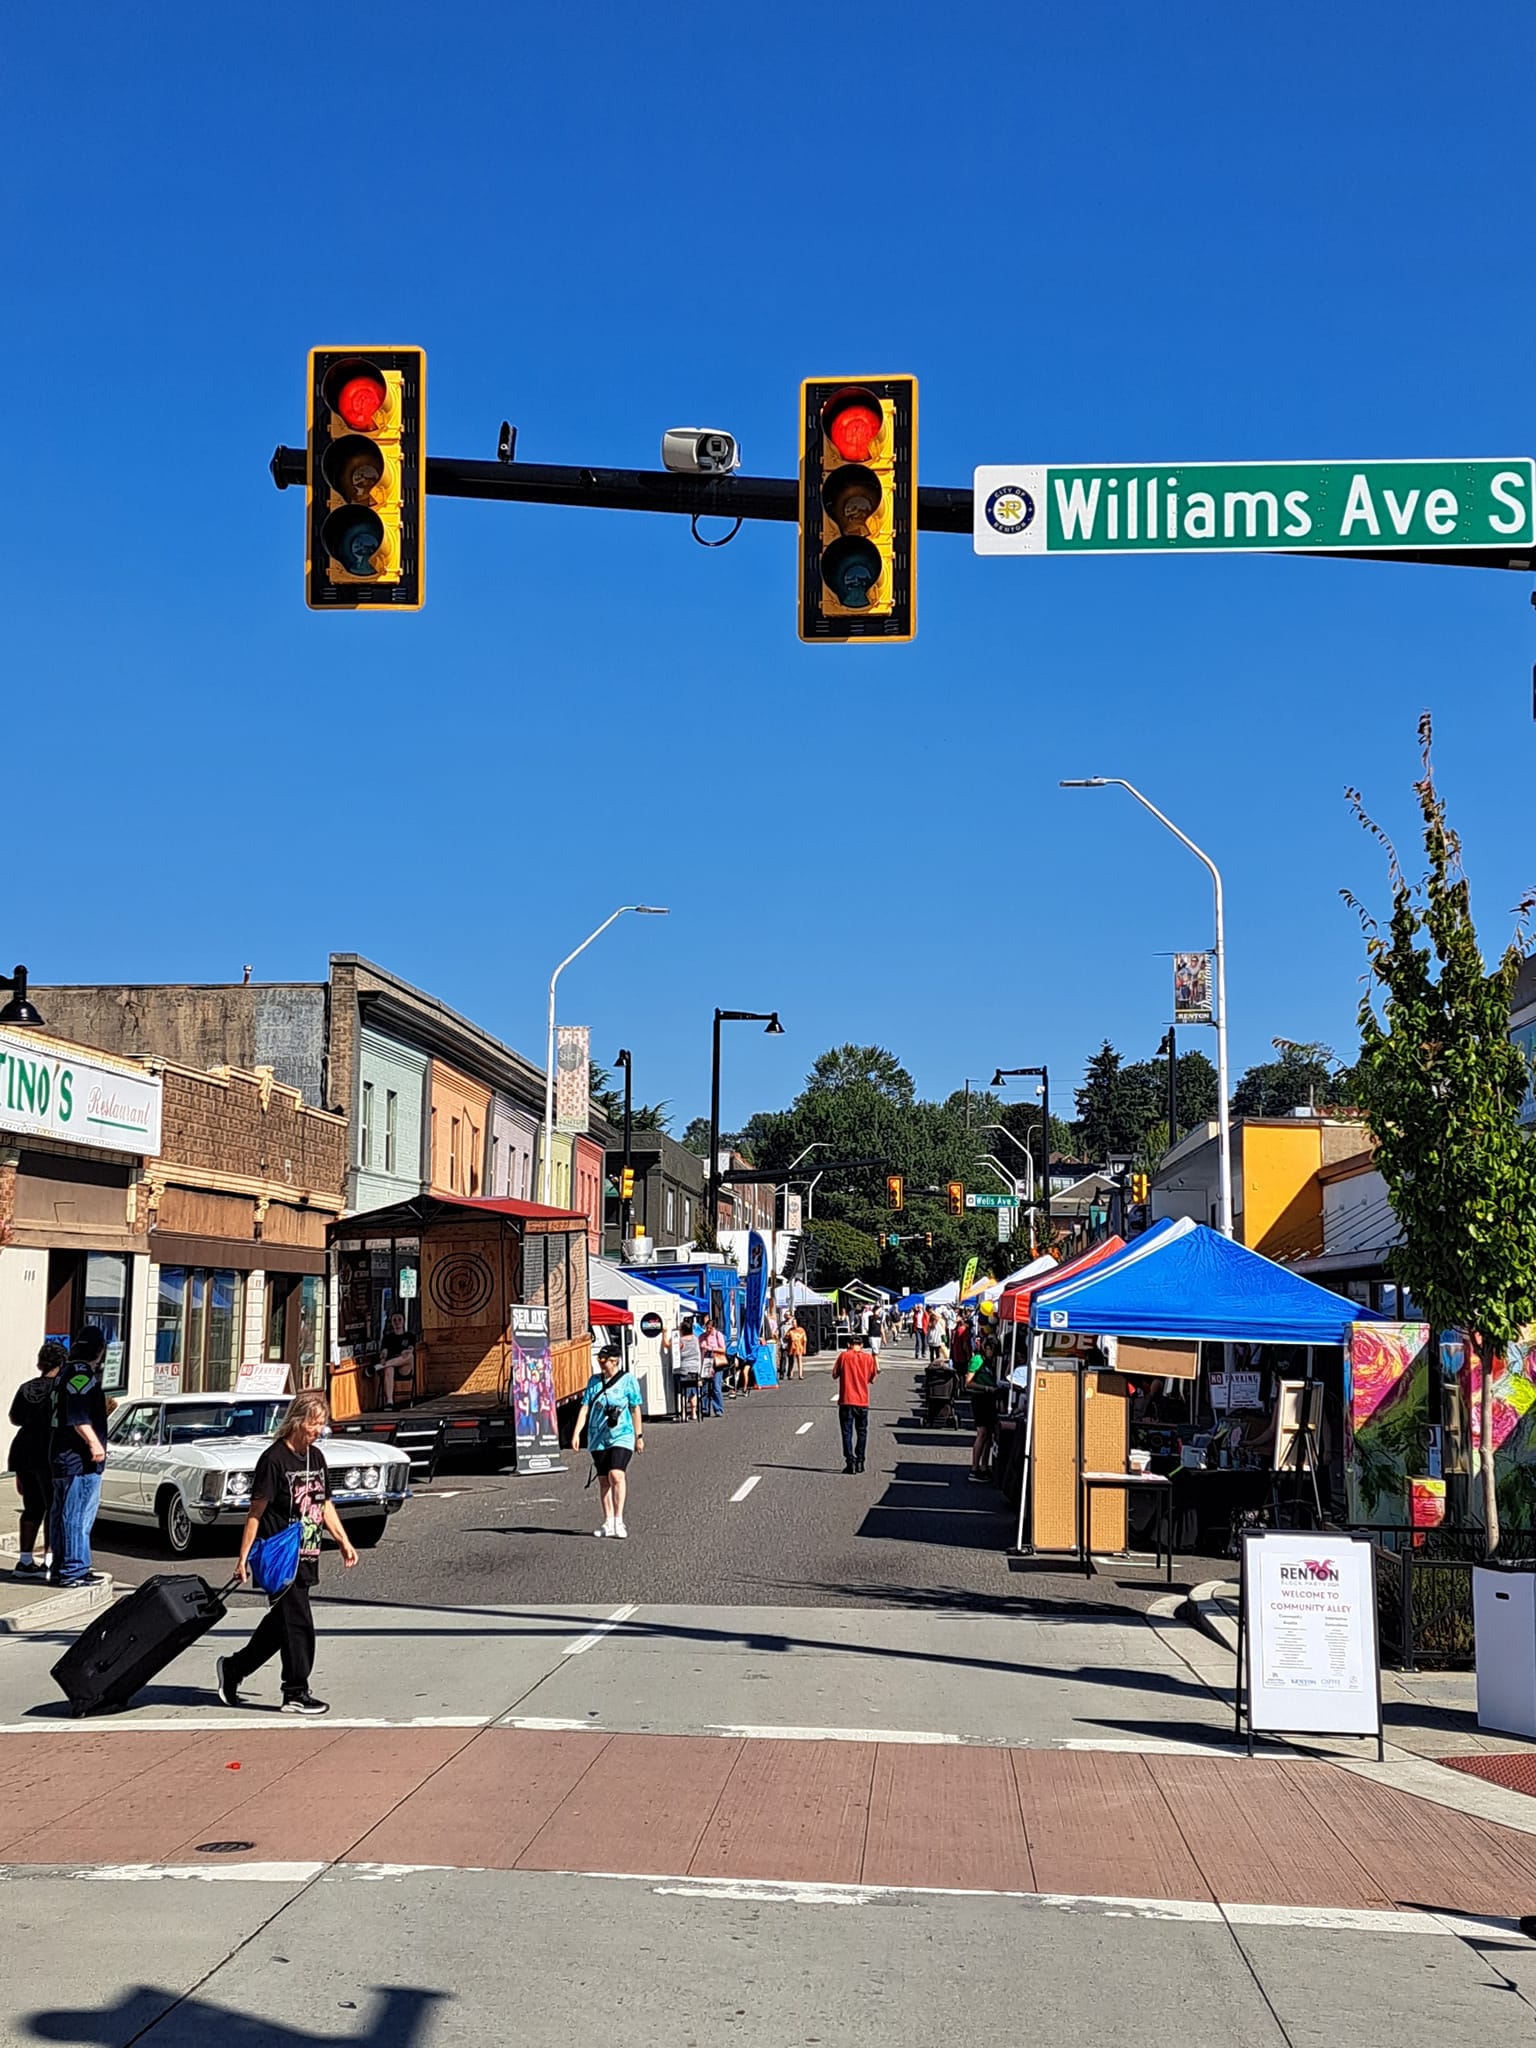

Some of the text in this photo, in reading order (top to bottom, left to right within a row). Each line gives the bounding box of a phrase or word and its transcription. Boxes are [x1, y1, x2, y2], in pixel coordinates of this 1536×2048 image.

[994, 487, 1026, 498] CITY OF
[1054, 471, 1527, 541] Williams Ave S
[87, 1086, 151, 1126] Restaurant
[976, 1196, 1020, 1206] Wells Ave S
[1211, 1374, 1222, 1384] NO
[1280, 1567, 1340, 1582] RENTON
[1281, 1590, 1340, 1600] WELCOME TO
[1270, 1602, 1352, 1614] COMMUNITY ALLEY
